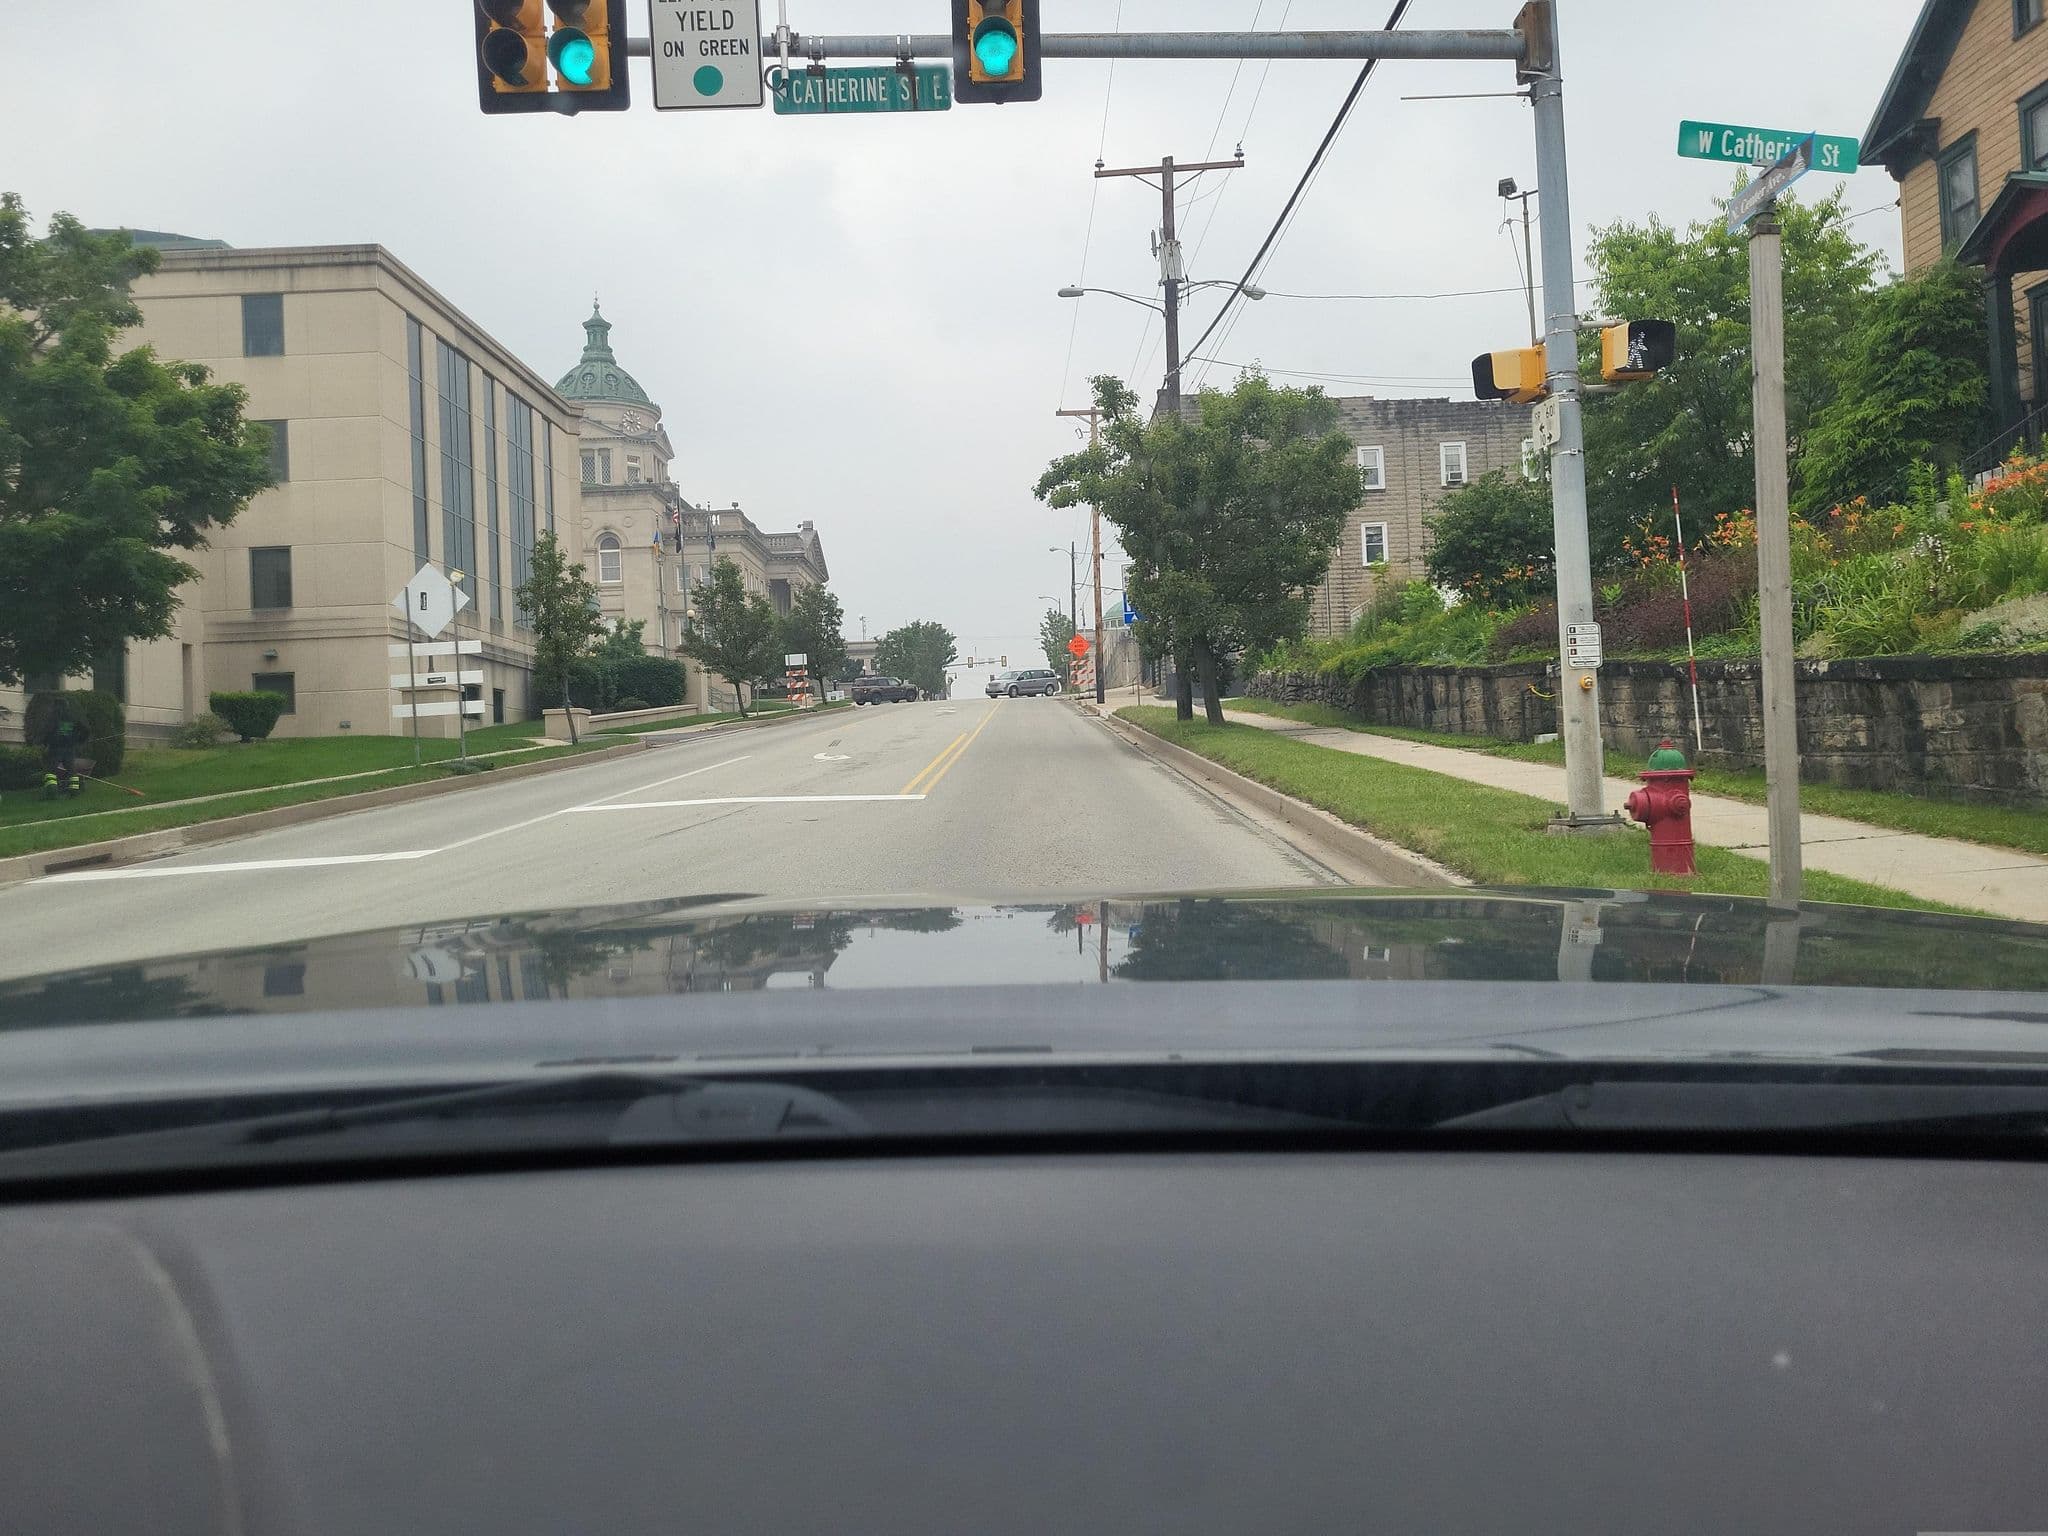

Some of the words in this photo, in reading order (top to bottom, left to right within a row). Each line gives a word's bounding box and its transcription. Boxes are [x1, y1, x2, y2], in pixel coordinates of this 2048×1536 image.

[675, 9, 734, 32] YIELD
[663, 40, 685, 58] ON
[699, 38, 749, 57] GREEN
[792, 76, 888, 105] CATHERINE
[900, 76, 920, 102] ST
[1698, 130, 1713, 154] W
[1721, 129, 1801, 161] Catheri
[1821, 144, 1841, 167] St
